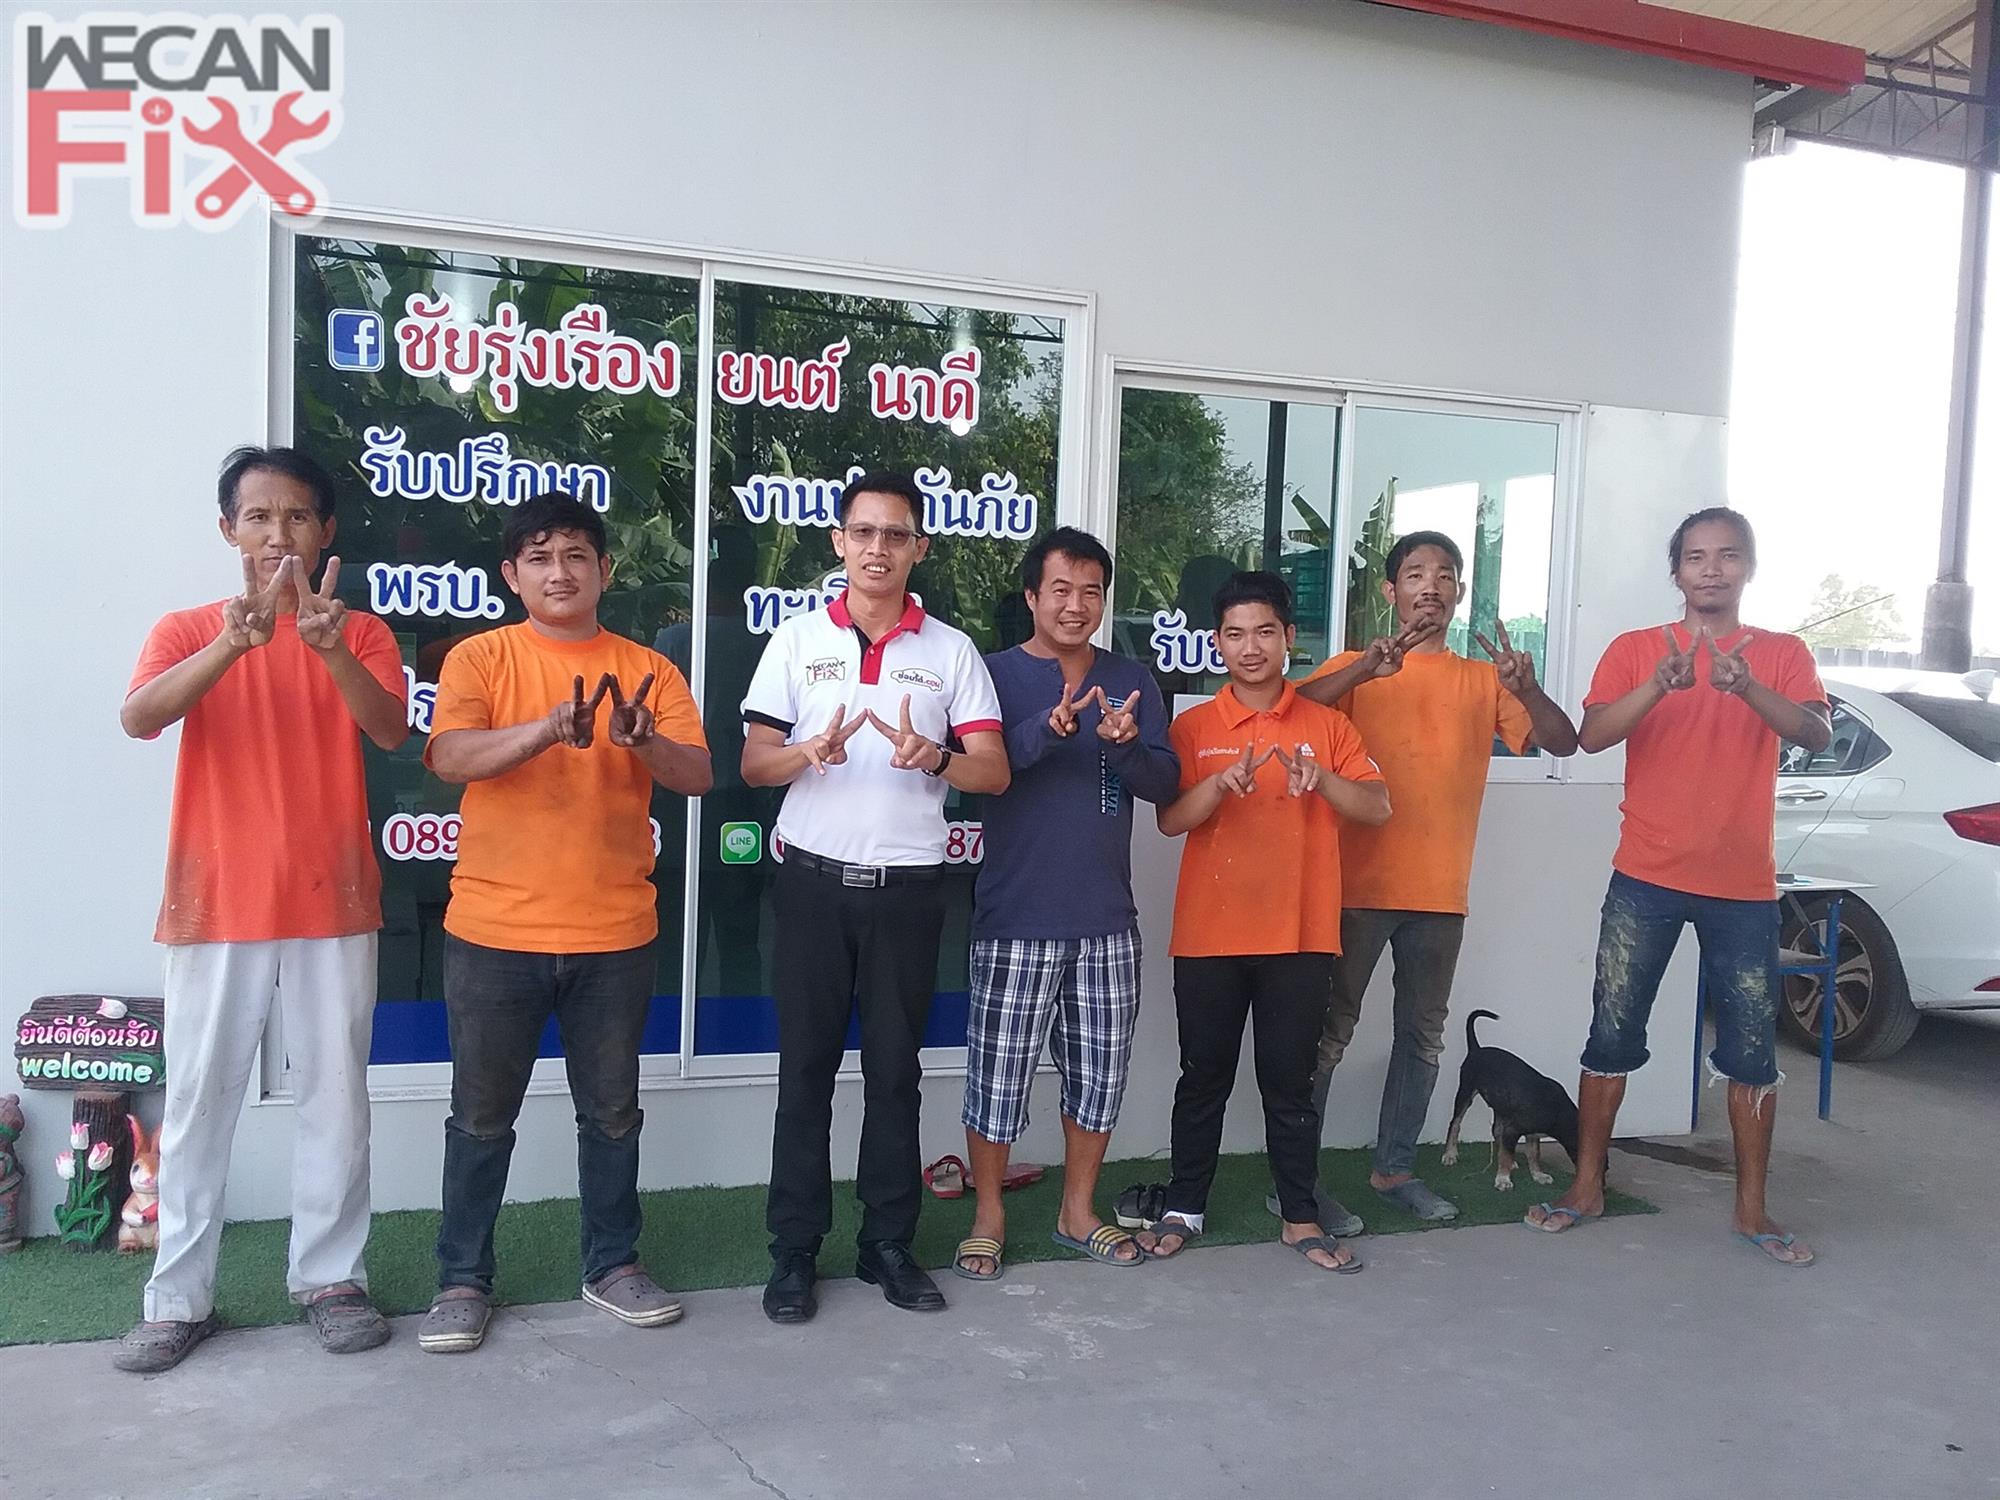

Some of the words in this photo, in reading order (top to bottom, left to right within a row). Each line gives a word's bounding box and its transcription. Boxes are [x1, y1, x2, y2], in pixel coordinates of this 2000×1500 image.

[399, 299, 674, 409] ชัยรุ่งเรือง
[719, 340, 848, 409] ยนต์
[872, 352, 976, 421] นาดี
[364, 430, 607, 508] รับปรึกษา
[375, 566, 499, 614] พรบ.
[730, 836, 751, 846] LINE
[19, 1014, 159, 1048] ยินดีต้อนรับ
[20, 1051, 153, 1084] welcome
